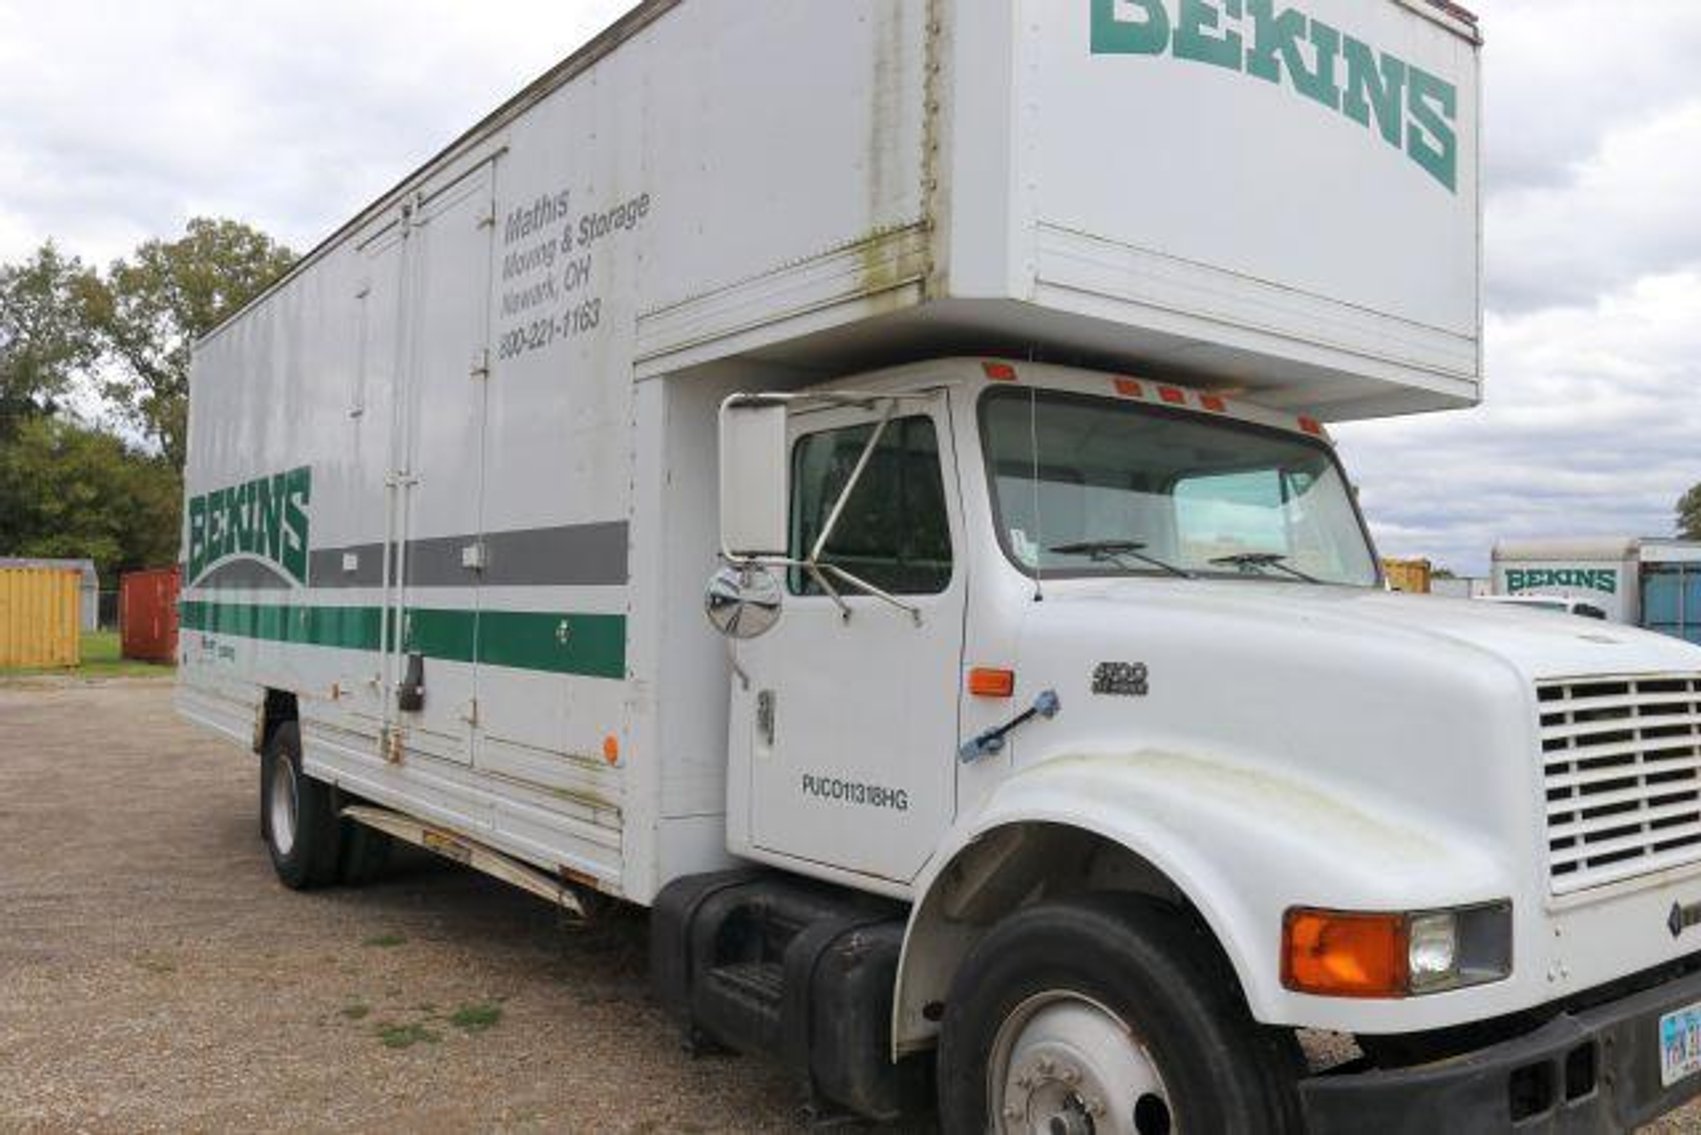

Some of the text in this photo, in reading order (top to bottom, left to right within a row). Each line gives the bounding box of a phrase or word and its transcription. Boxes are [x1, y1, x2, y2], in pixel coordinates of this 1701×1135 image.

[503, 192, 650, 281] Moving & Storage
[506, 190, 569, 245] Mathis
[563, 254, 592, 292] OH
[189, 466, 311, 586] BEKINS
[1506, 569, 1616, 594] BEKINS
